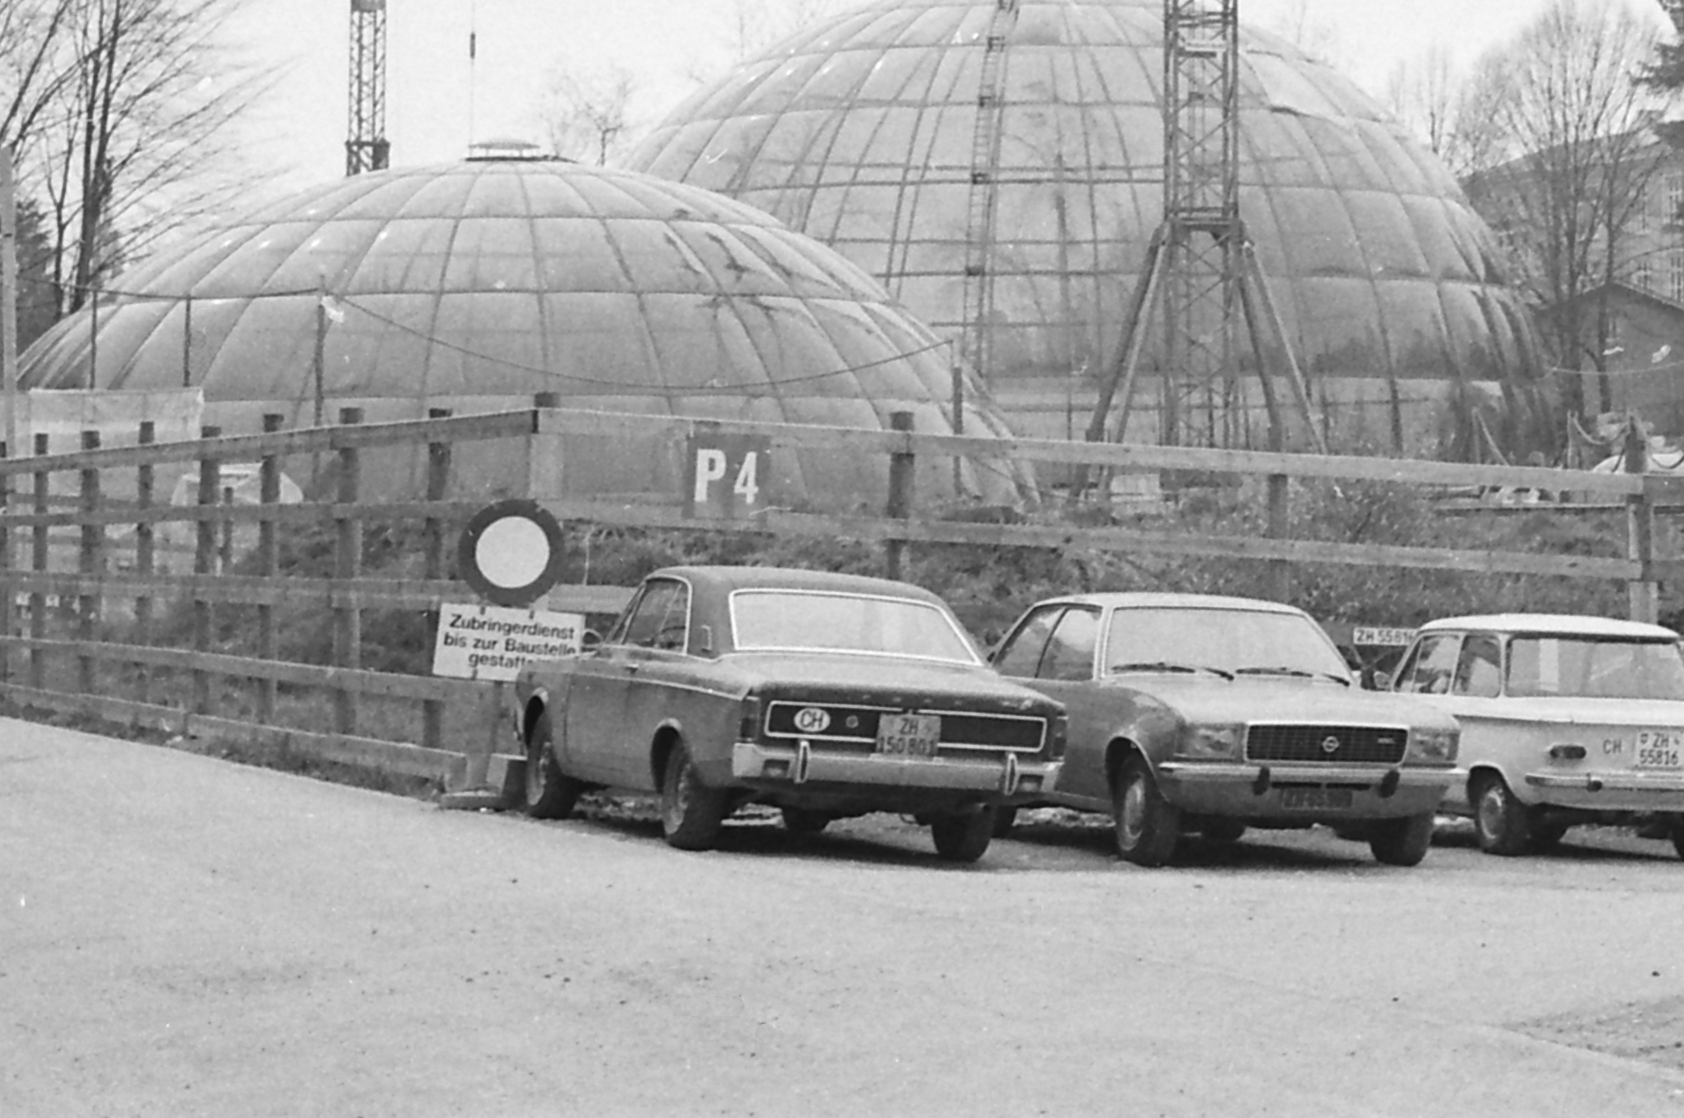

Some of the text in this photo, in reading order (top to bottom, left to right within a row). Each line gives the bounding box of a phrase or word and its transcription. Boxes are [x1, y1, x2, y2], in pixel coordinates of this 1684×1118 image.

[449, 613, 576, 639] Zubringerdienst
[443, 632, 577, 656] bis zur Baustelle
[800, 710, 824, 729] CH
[900, 717, 919, 735] ZH
[1602, 739, 1623, 754] CH
[1653, 732, 1670, 748] ZH
[1639, 749, 1680, 765] 55816
